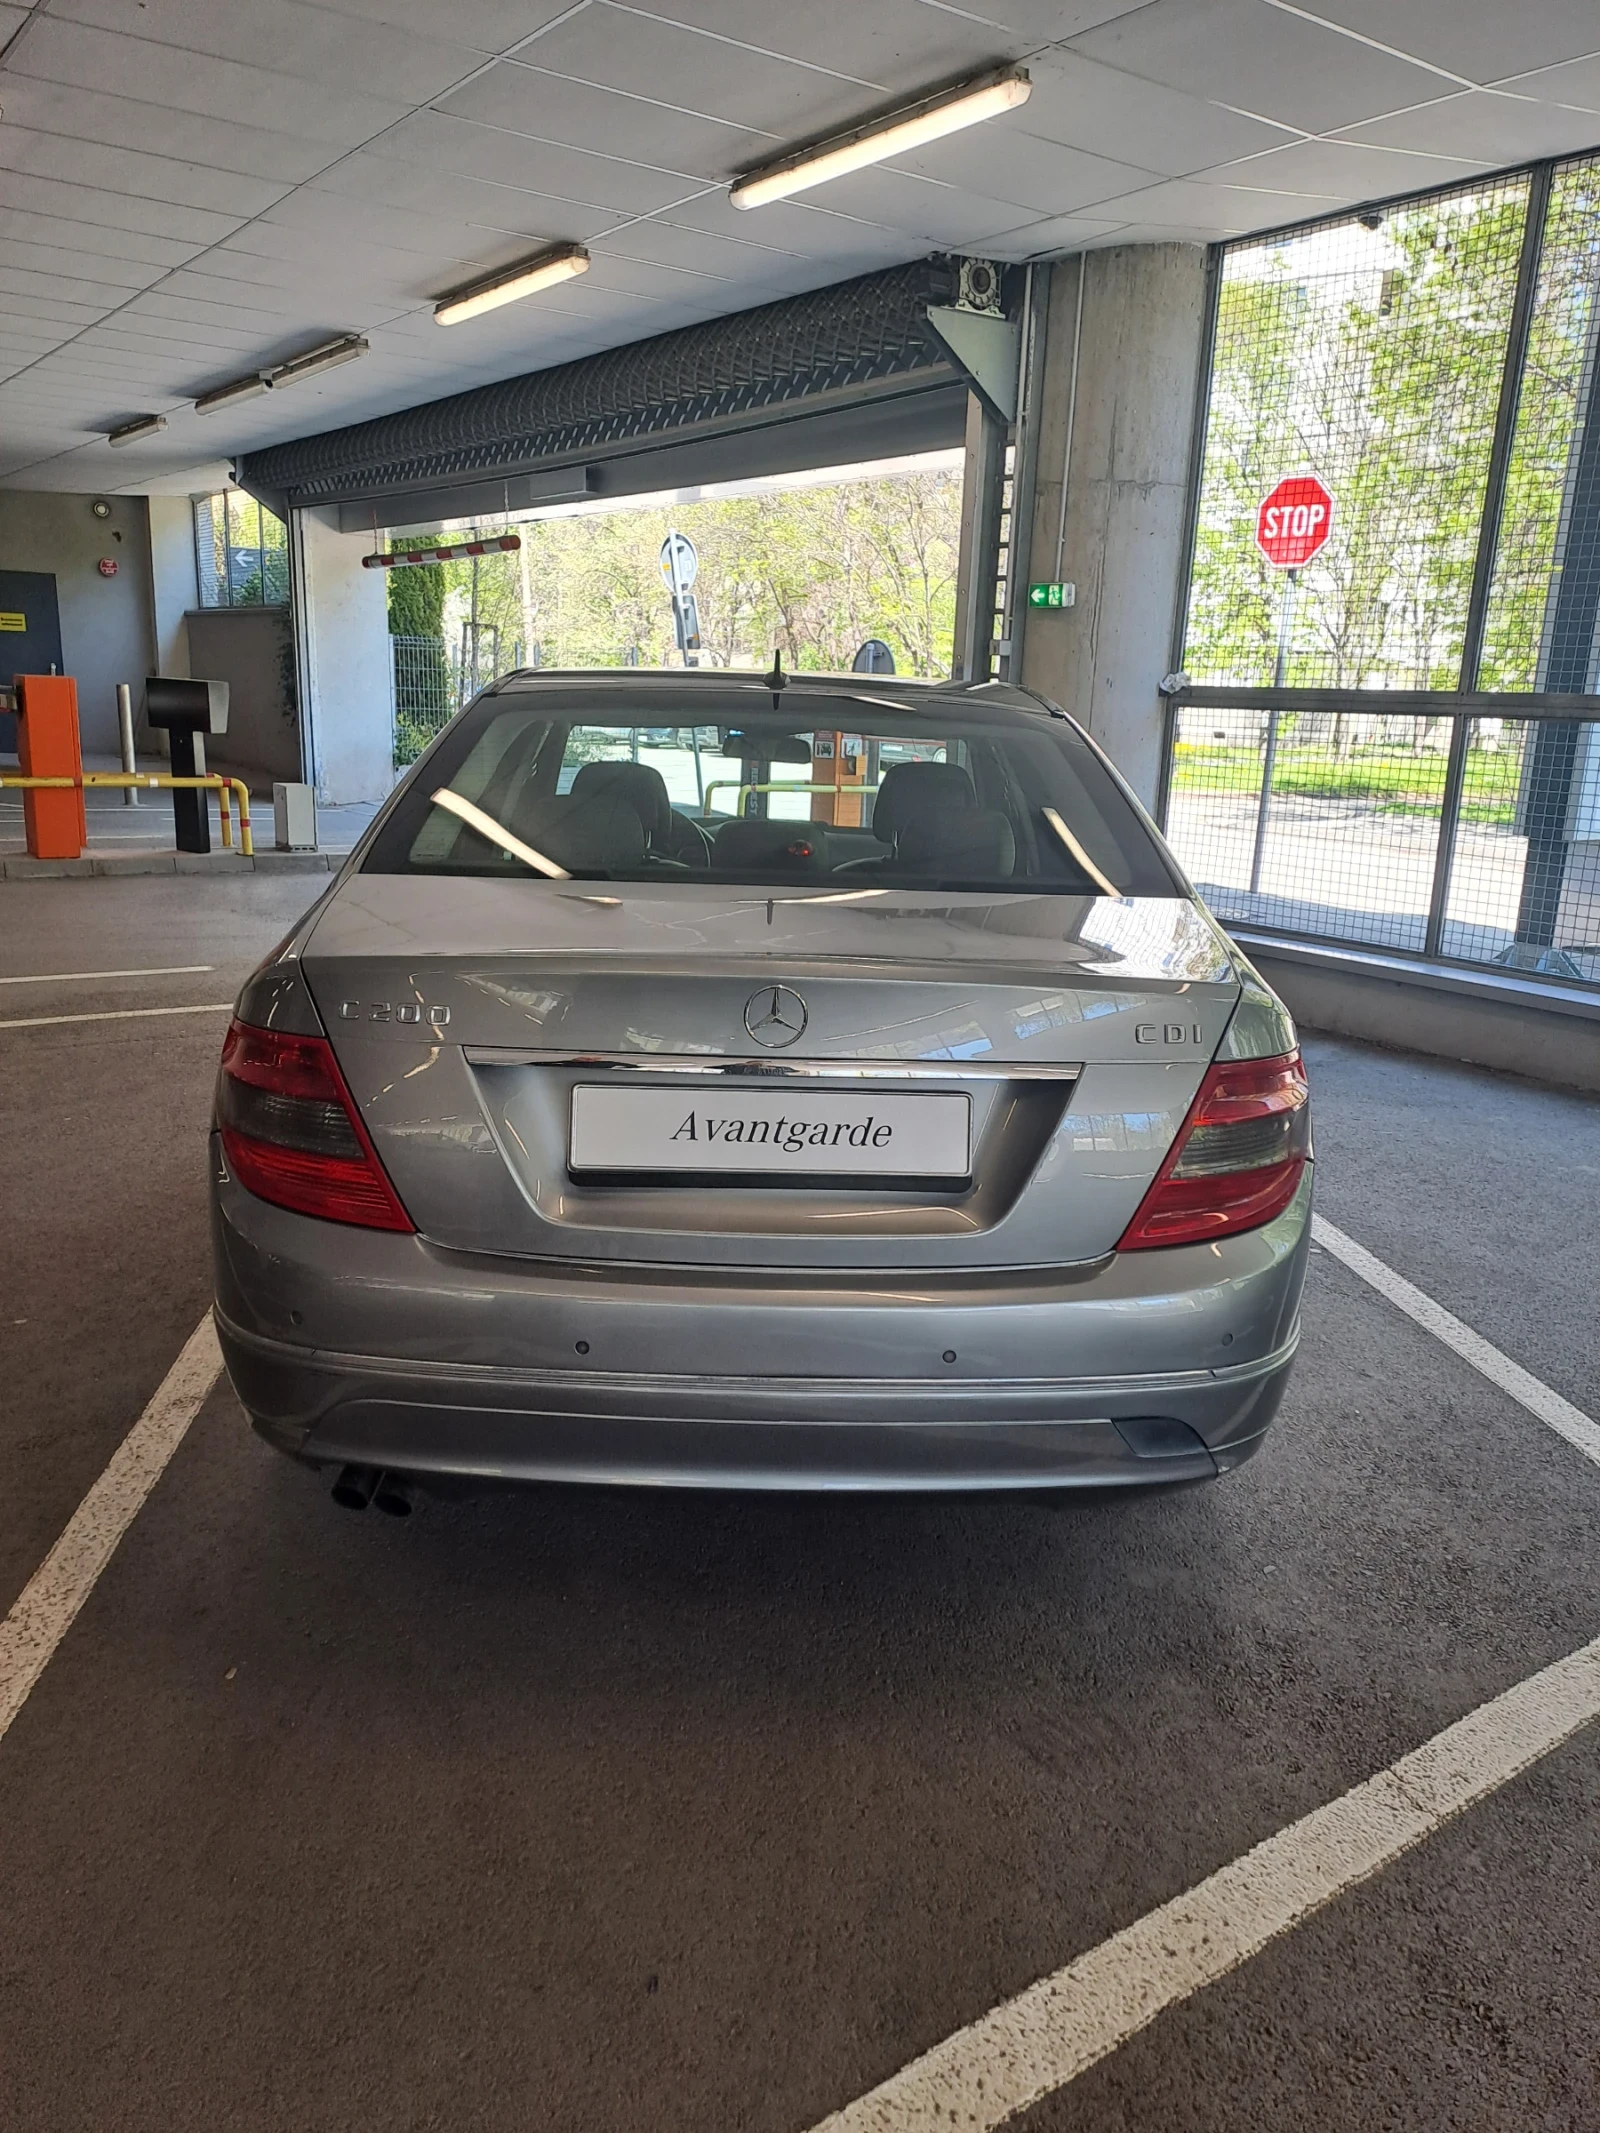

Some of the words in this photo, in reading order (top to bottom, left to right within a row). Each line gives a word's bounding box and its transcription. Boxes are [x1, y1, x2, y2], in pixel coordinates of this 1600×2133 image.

[1264, 504, 1325, 539] STOP
[339, 1000, 360, 1020] C
[368, 1002, 451, 1026] 200
[1135, 1023, 1202, 1044] CDI
[669, 1110, 893, 1153] Avantgarde
